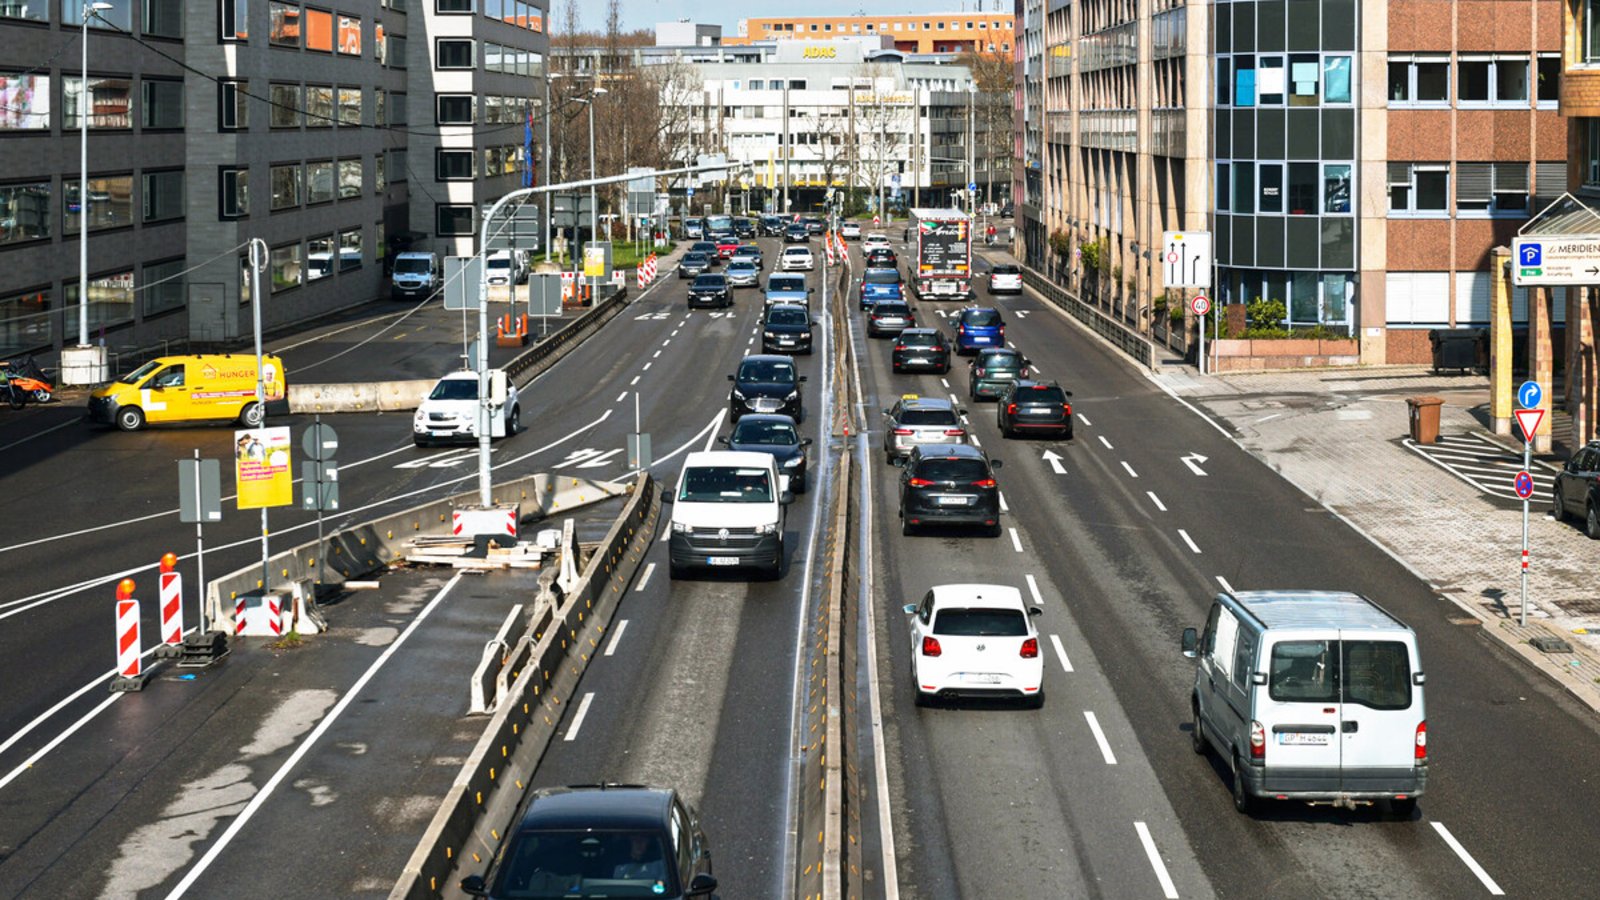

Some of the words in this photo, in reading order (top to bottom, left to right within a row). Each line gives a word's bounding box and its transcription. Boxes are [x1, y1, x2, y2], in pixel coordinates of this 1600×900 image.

[803, 46, 836, 58] ADAC
[1558, 244, 1600, 253] MERIDIEN
[1527, 251, 1536, 263] P
[1196, 301, 1206, 310] 40
[220, 370, 255, 378] HUNGER
